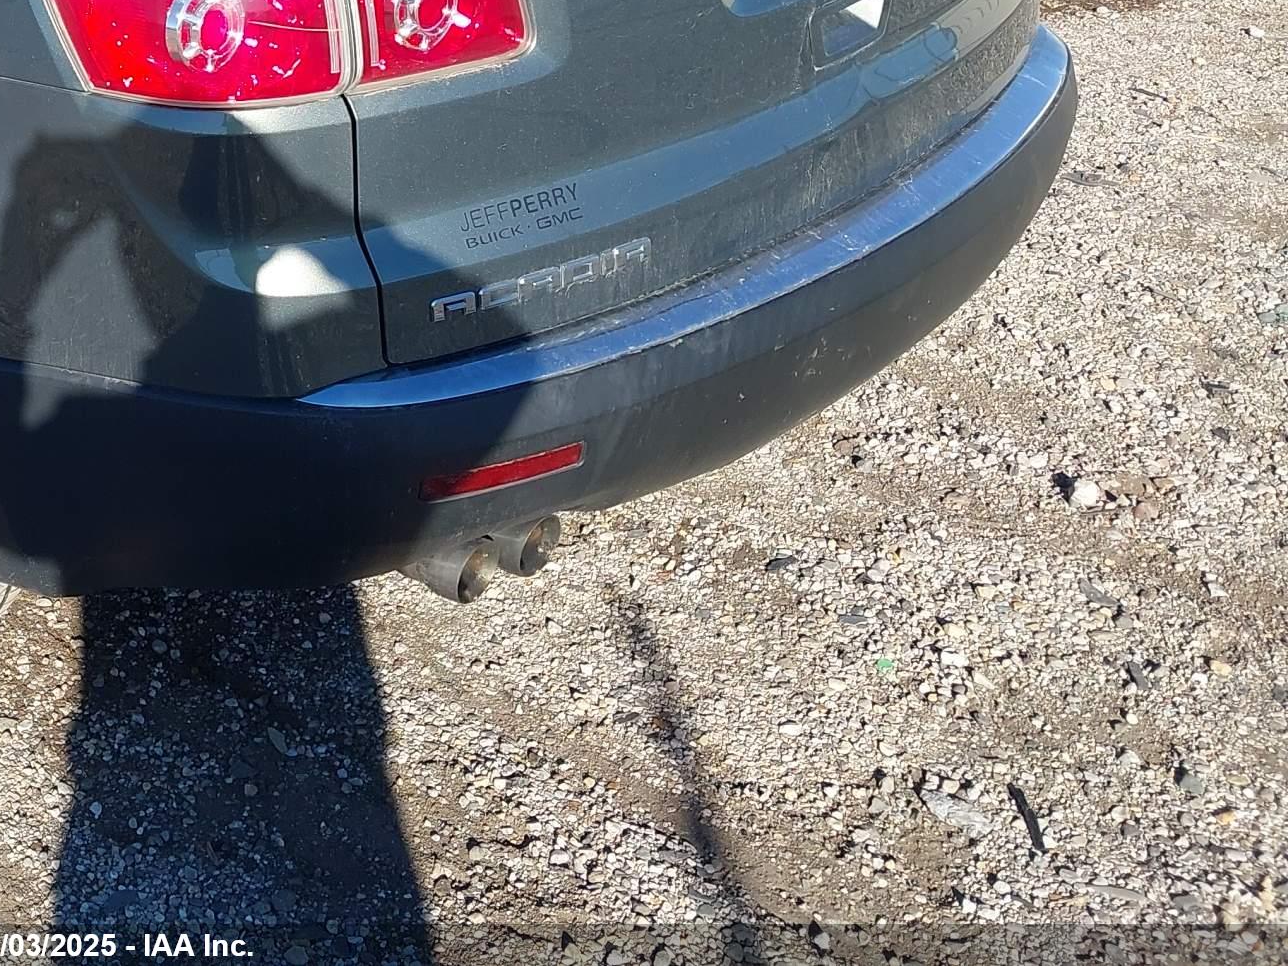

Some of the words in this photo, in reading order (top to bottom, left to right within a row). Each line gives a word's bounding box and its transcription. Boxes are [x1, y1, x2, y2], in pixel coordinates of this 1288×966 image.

[465, 225, 523, 249] BUICK
[536, 207, 584, 230] GMC
[430, 237, 653, 323] ACADIA
